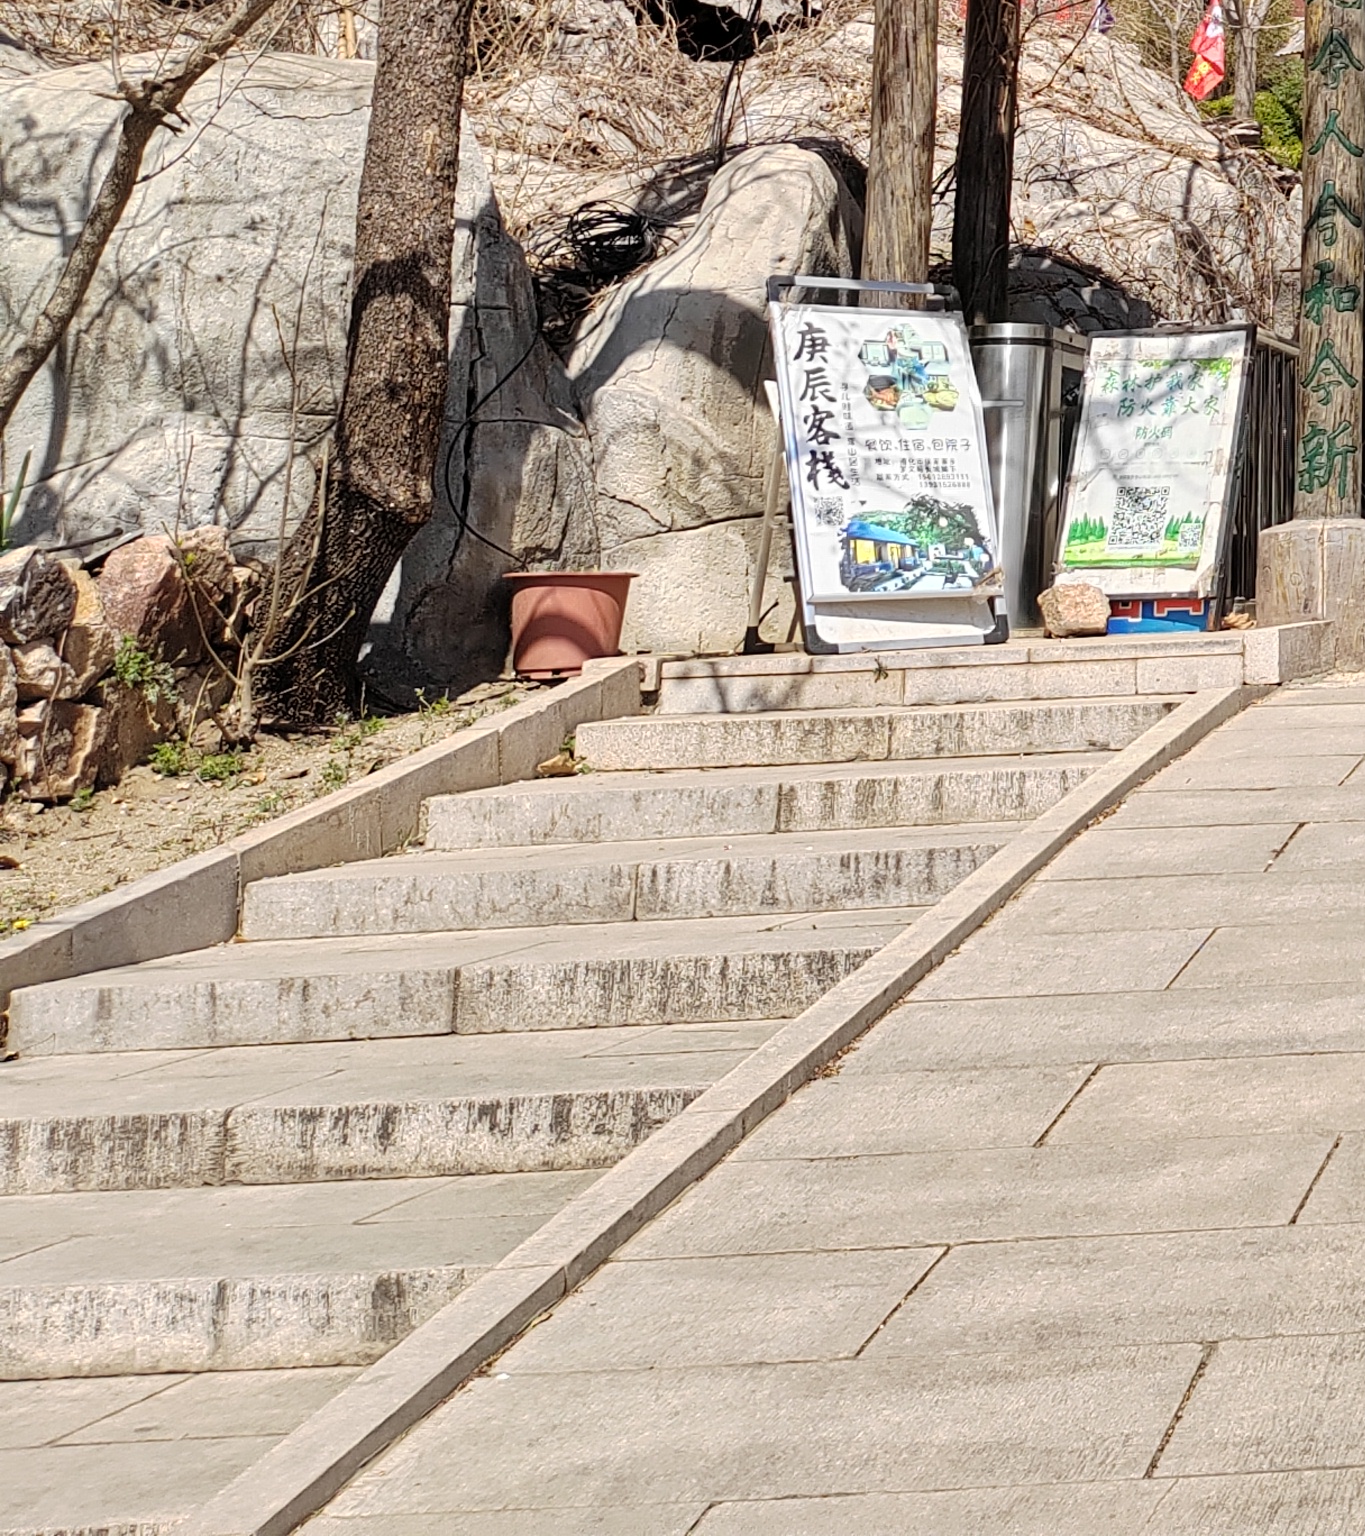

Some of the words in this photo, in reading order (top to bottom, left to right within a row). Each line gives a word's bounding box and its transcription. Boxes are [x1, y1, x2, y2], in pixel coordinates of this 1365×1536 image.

[1116, 395, 1220, 418] 防火靠大家
